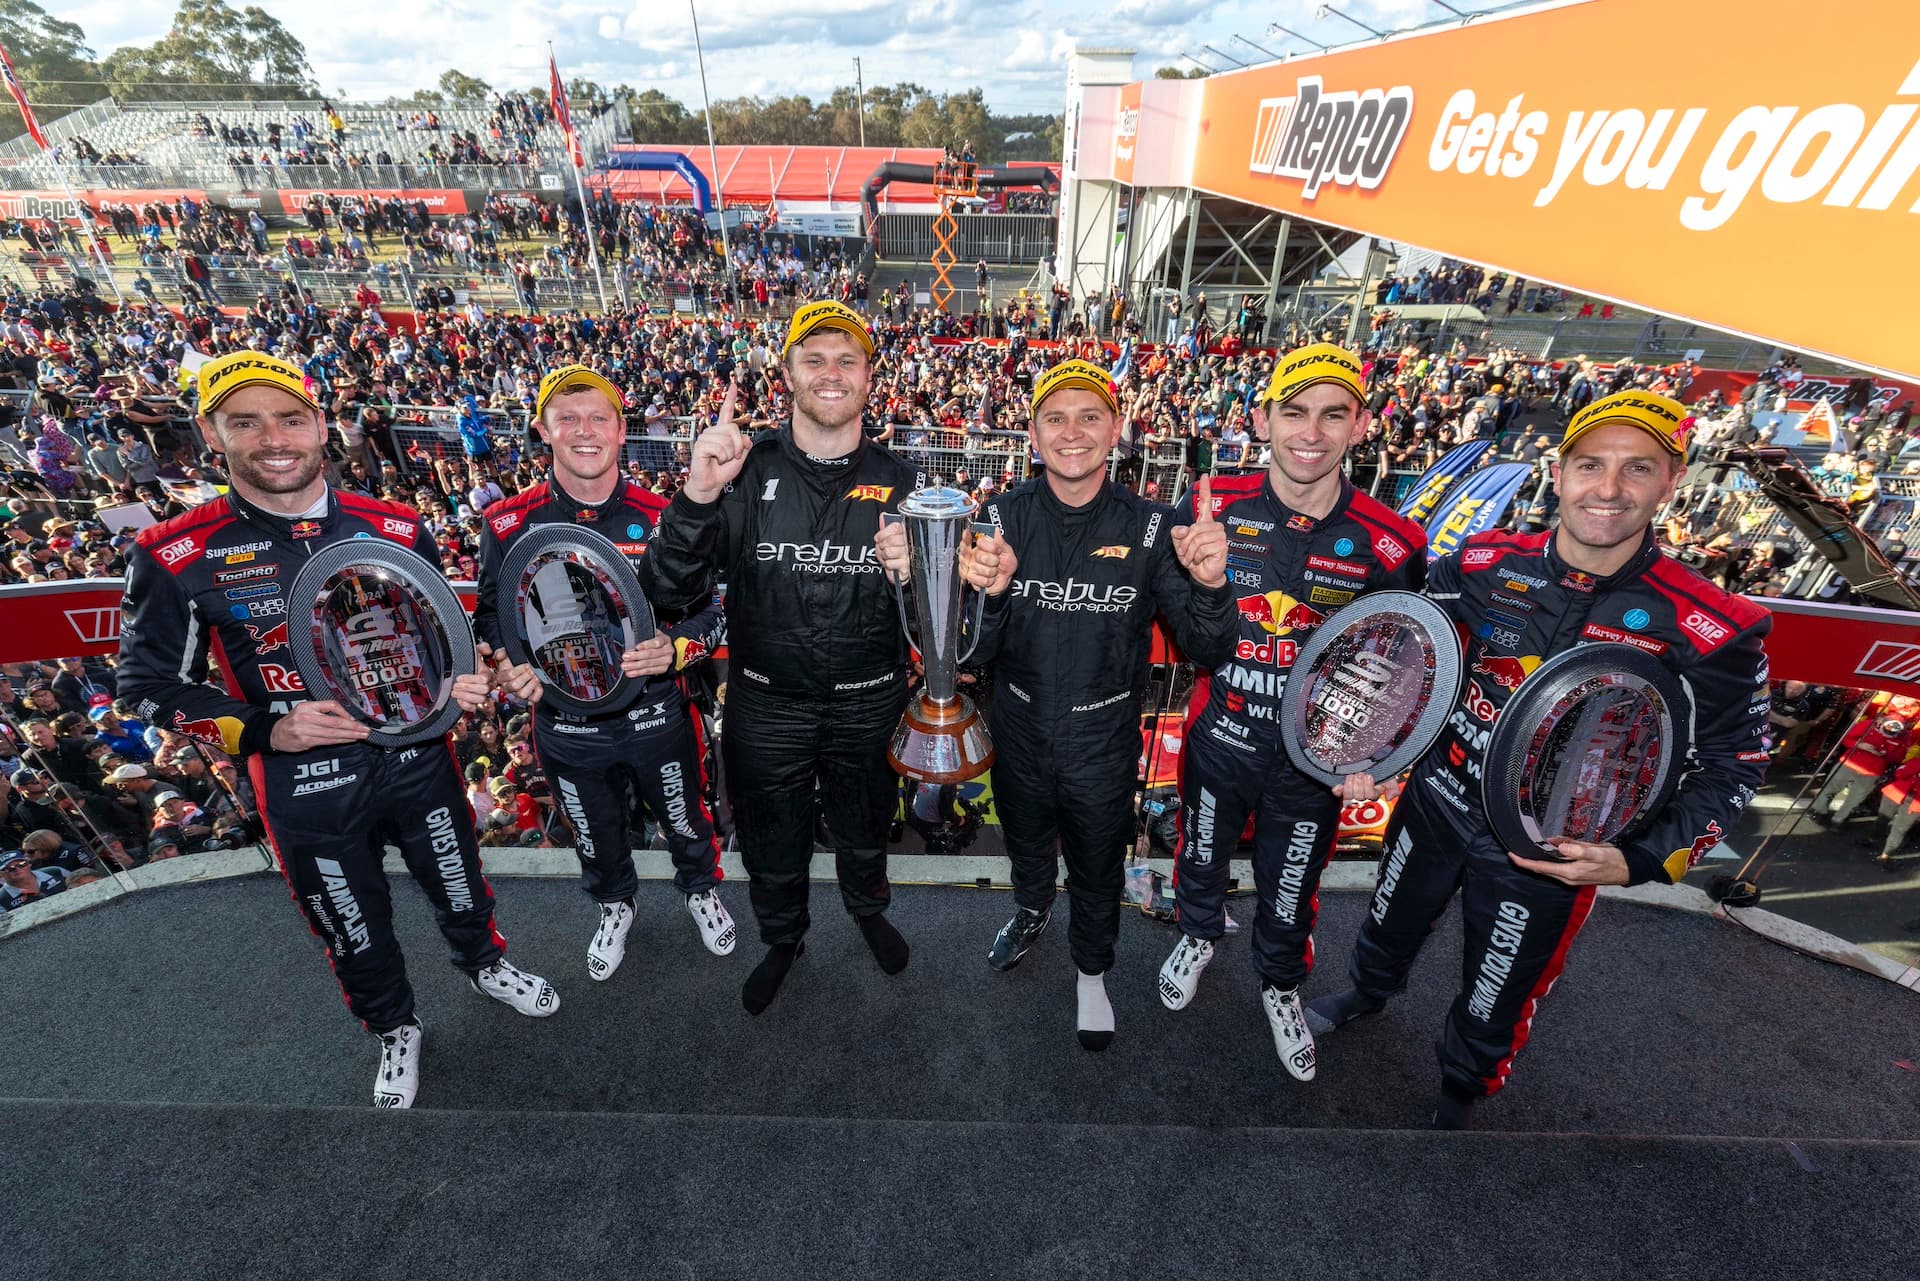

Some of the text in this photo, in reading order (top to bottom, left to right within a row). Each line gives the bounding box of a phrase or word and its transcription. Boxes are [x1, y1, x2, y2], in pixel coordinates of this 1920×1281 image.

[1279, 79, 1412, 196] Repco
[1428, 88, 1548, 179] Gets
[1533, 107, 1707, 207] you
[23, 195, 78, 223] Repc
[798, 304, 862, 327] DUNLO
[208, 359, 302, 389] DUNLOP
[1040, 363, 1110, 388] DUNLOP
[1282, 354, 1362, 377] DUNLOP
[1789, 380, 1901, 406] Repo
[1574, 397, 1680, 427] DUNLOP
[761, 478, 780, 501] 1
[1408, 473, 1455, 521] TEK
[494, 514, 518, 531] OMP
[989, 504, 1005, 535] sparo
[1227, 516, 1275, 532] SUPERCHEAP
[1475, 501, 1498, 528] LANE
[383, 521, 414, 535] OMP
[1143, 512, 1161, 547] sparco
[162, 538, 195, 562] OMP
[206, 541, 273, 559] SUPERCHEAP
[229, 554, 254, 562] AUTO
[756, 539, 878, 565] erebus
[1378, 538, 1403, 560] OMP
[1465, 551, 1494, 562] OMP
[218, 567, 274, 582] ToolPRO
[1235, 570, 1261, 581] QUAD
[1309, 557, 1366, 575] Harvey Norman
[1012, 577, 1137, 604] erebus
[1235, 577, 1261, 589] LOCK
[1315, 575, 1365, 590] NEW HOLLAND
[1497, 568, 1548, 590] SUPERCHEAP
[1508, 582, 1527, 591] AUTO
[248, 598, 285, 611] QUAD
[250, 606, 287, 618] LOCK
[1037, 599, 1133, 614] motorsport
[1493, 627, 1520, 643] QUAD
[1587, 625, 1662, 652] Harvey Norman
[1686, 614, 1724, 640] OMP
[543, 636, 600, 650] BATHUR
[1235, 634, 1276, 664] ed
[1491, 634, 1520, 650] LOCK
[350, 656, 409, 674] BATHUR
[258, 663, 306, 693] Re
[351, 666, 415, 690] 1000
[834, 672, 894, 691] KOSTECKI
[1071, 690, 1131, 712] HAZELWOOD
[1317, 692, 1370, 728] 1000
[634, 717, 666, 732] BROWN
[400, 747, 419, 763] PYE
[293, 758, 340, 780] JGI
[660, 761, 685, 798] GIVES
[293, 774, 358, 794] ACDelco
[426, 807, 456, 853] GIVES
[561, 792, 597, 860] AMPLIFY
[1285, 821, 1319, 864] GIVES
[437, 848, 462, 883] YOU
[1278, 863, 1308, 893] YOU
[1371, 841, 1407, 926] AMPLIFY
[307, 894, 345, 958] Premium Fuels
[322, 874, 371, 955] AMPLIFY
[1490, 900, 1531, 955] GIVES
[1479, 946, 1518, 981] YOU
